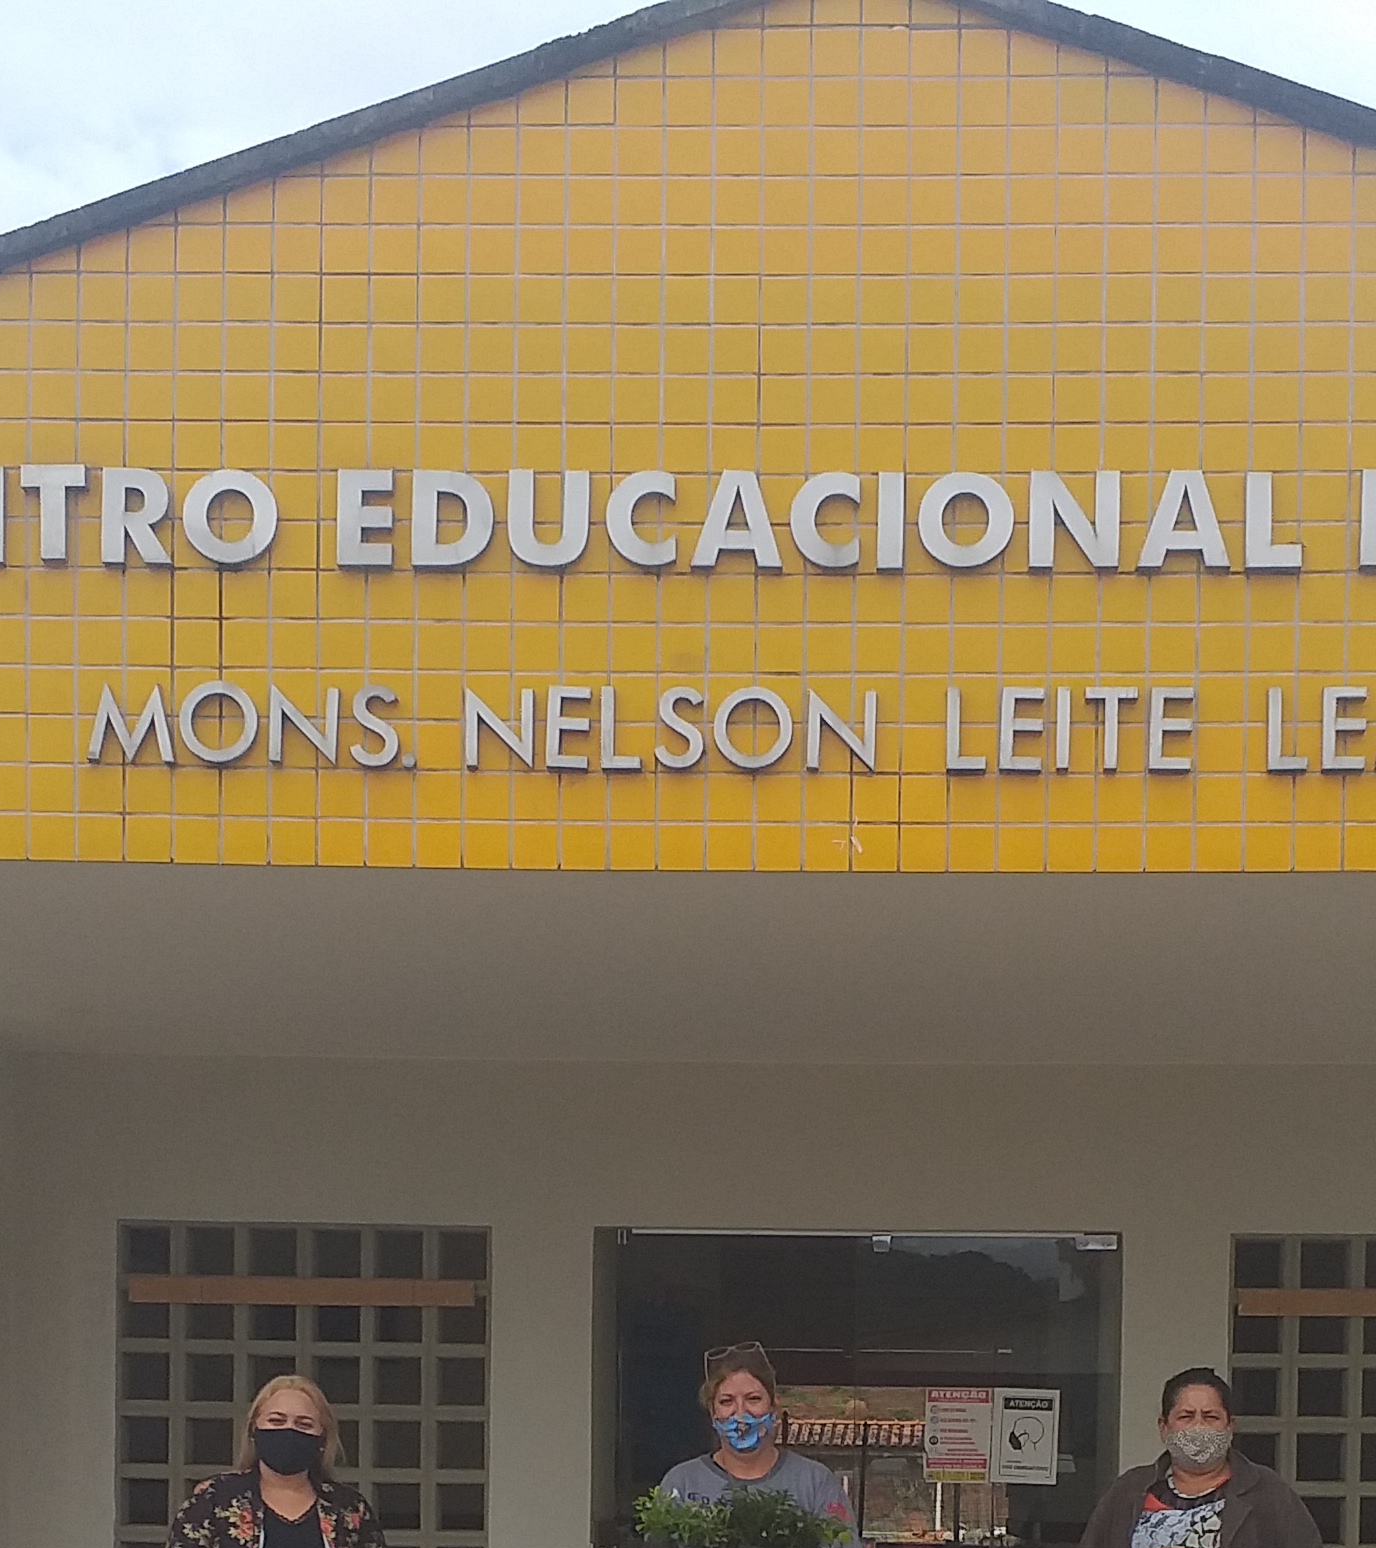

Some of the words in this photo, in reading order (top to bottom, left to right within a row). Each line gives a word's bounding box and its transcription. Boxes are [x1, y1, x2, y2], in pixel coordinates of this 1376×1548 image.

[335, 467, 1303, 572] EDUCACIONAL
[86, 680, 417, 769] MONS.
[464, 685, 876, 772] NELSON
[947, 685, 1196, 773] LEITE
[1009, 1399, 1048, 1409] ATENÇÃO
